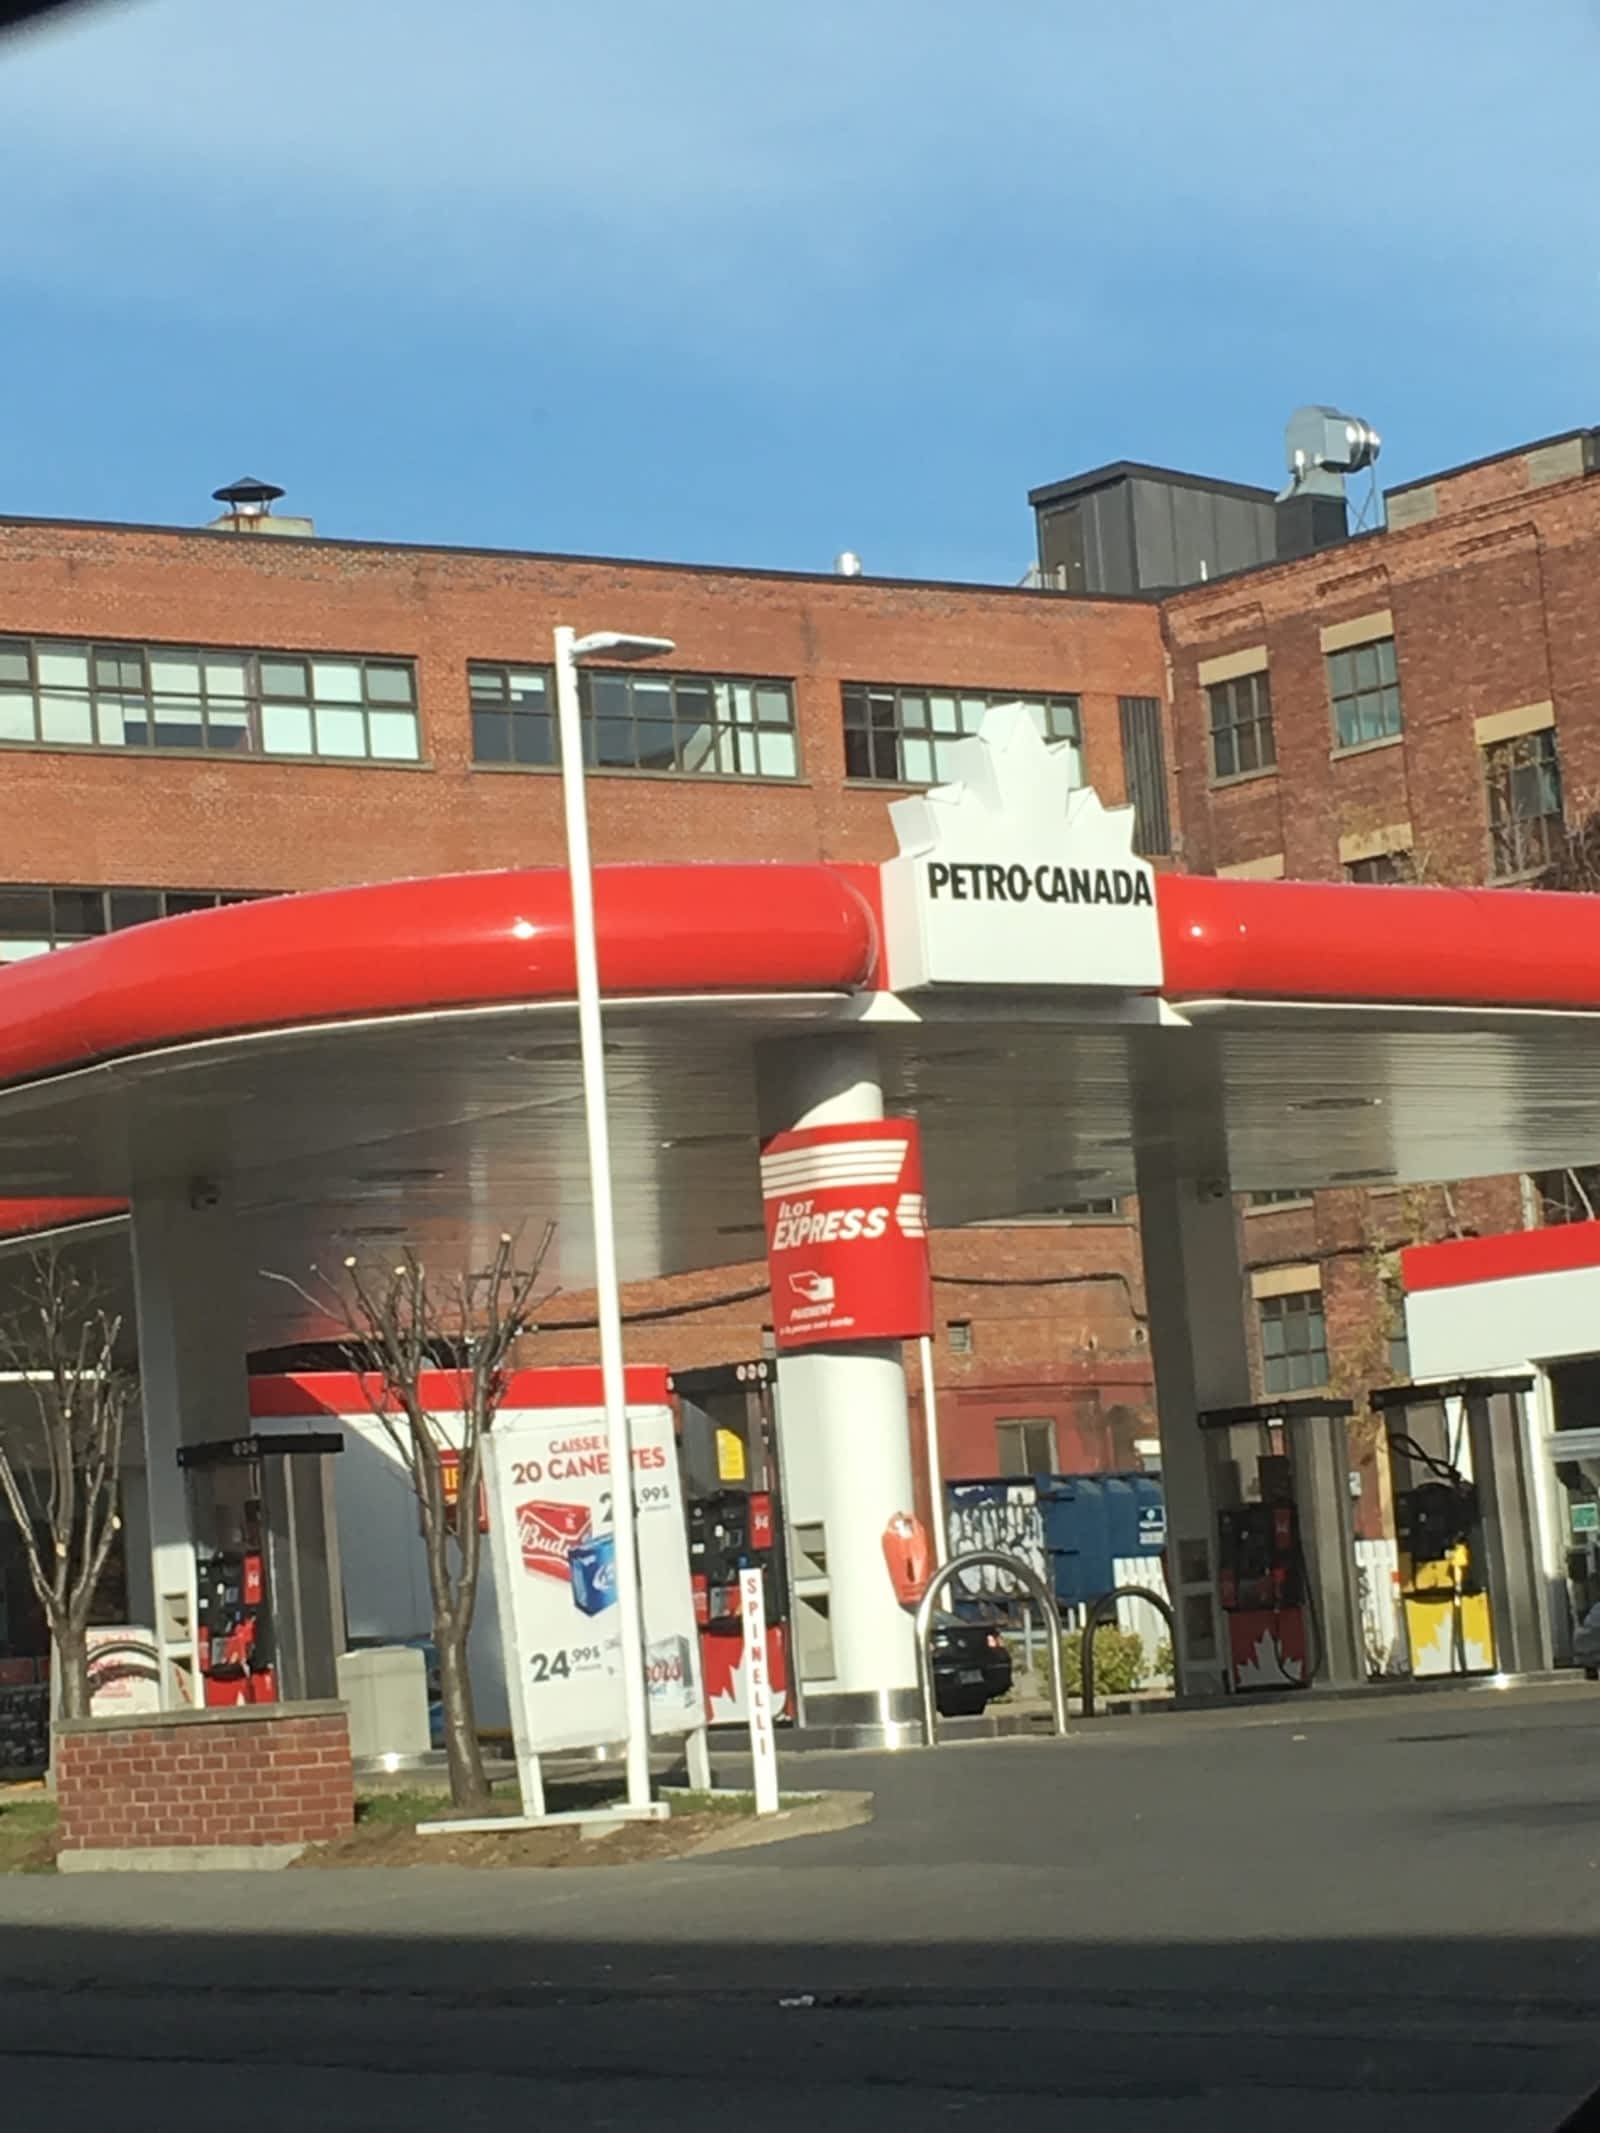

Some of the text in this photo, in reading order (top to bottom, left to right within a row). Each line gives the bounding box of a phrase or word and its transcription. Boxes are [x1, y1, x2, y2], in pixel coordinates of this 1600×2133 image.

[772, 1207, 889, 1250] EXPRESS
[549, 1435, 600, 1454] CAISSE
[511, 1446, 666, 1485] 20 CANETES
[746, 1577, 767, 1757] SPINELLI
